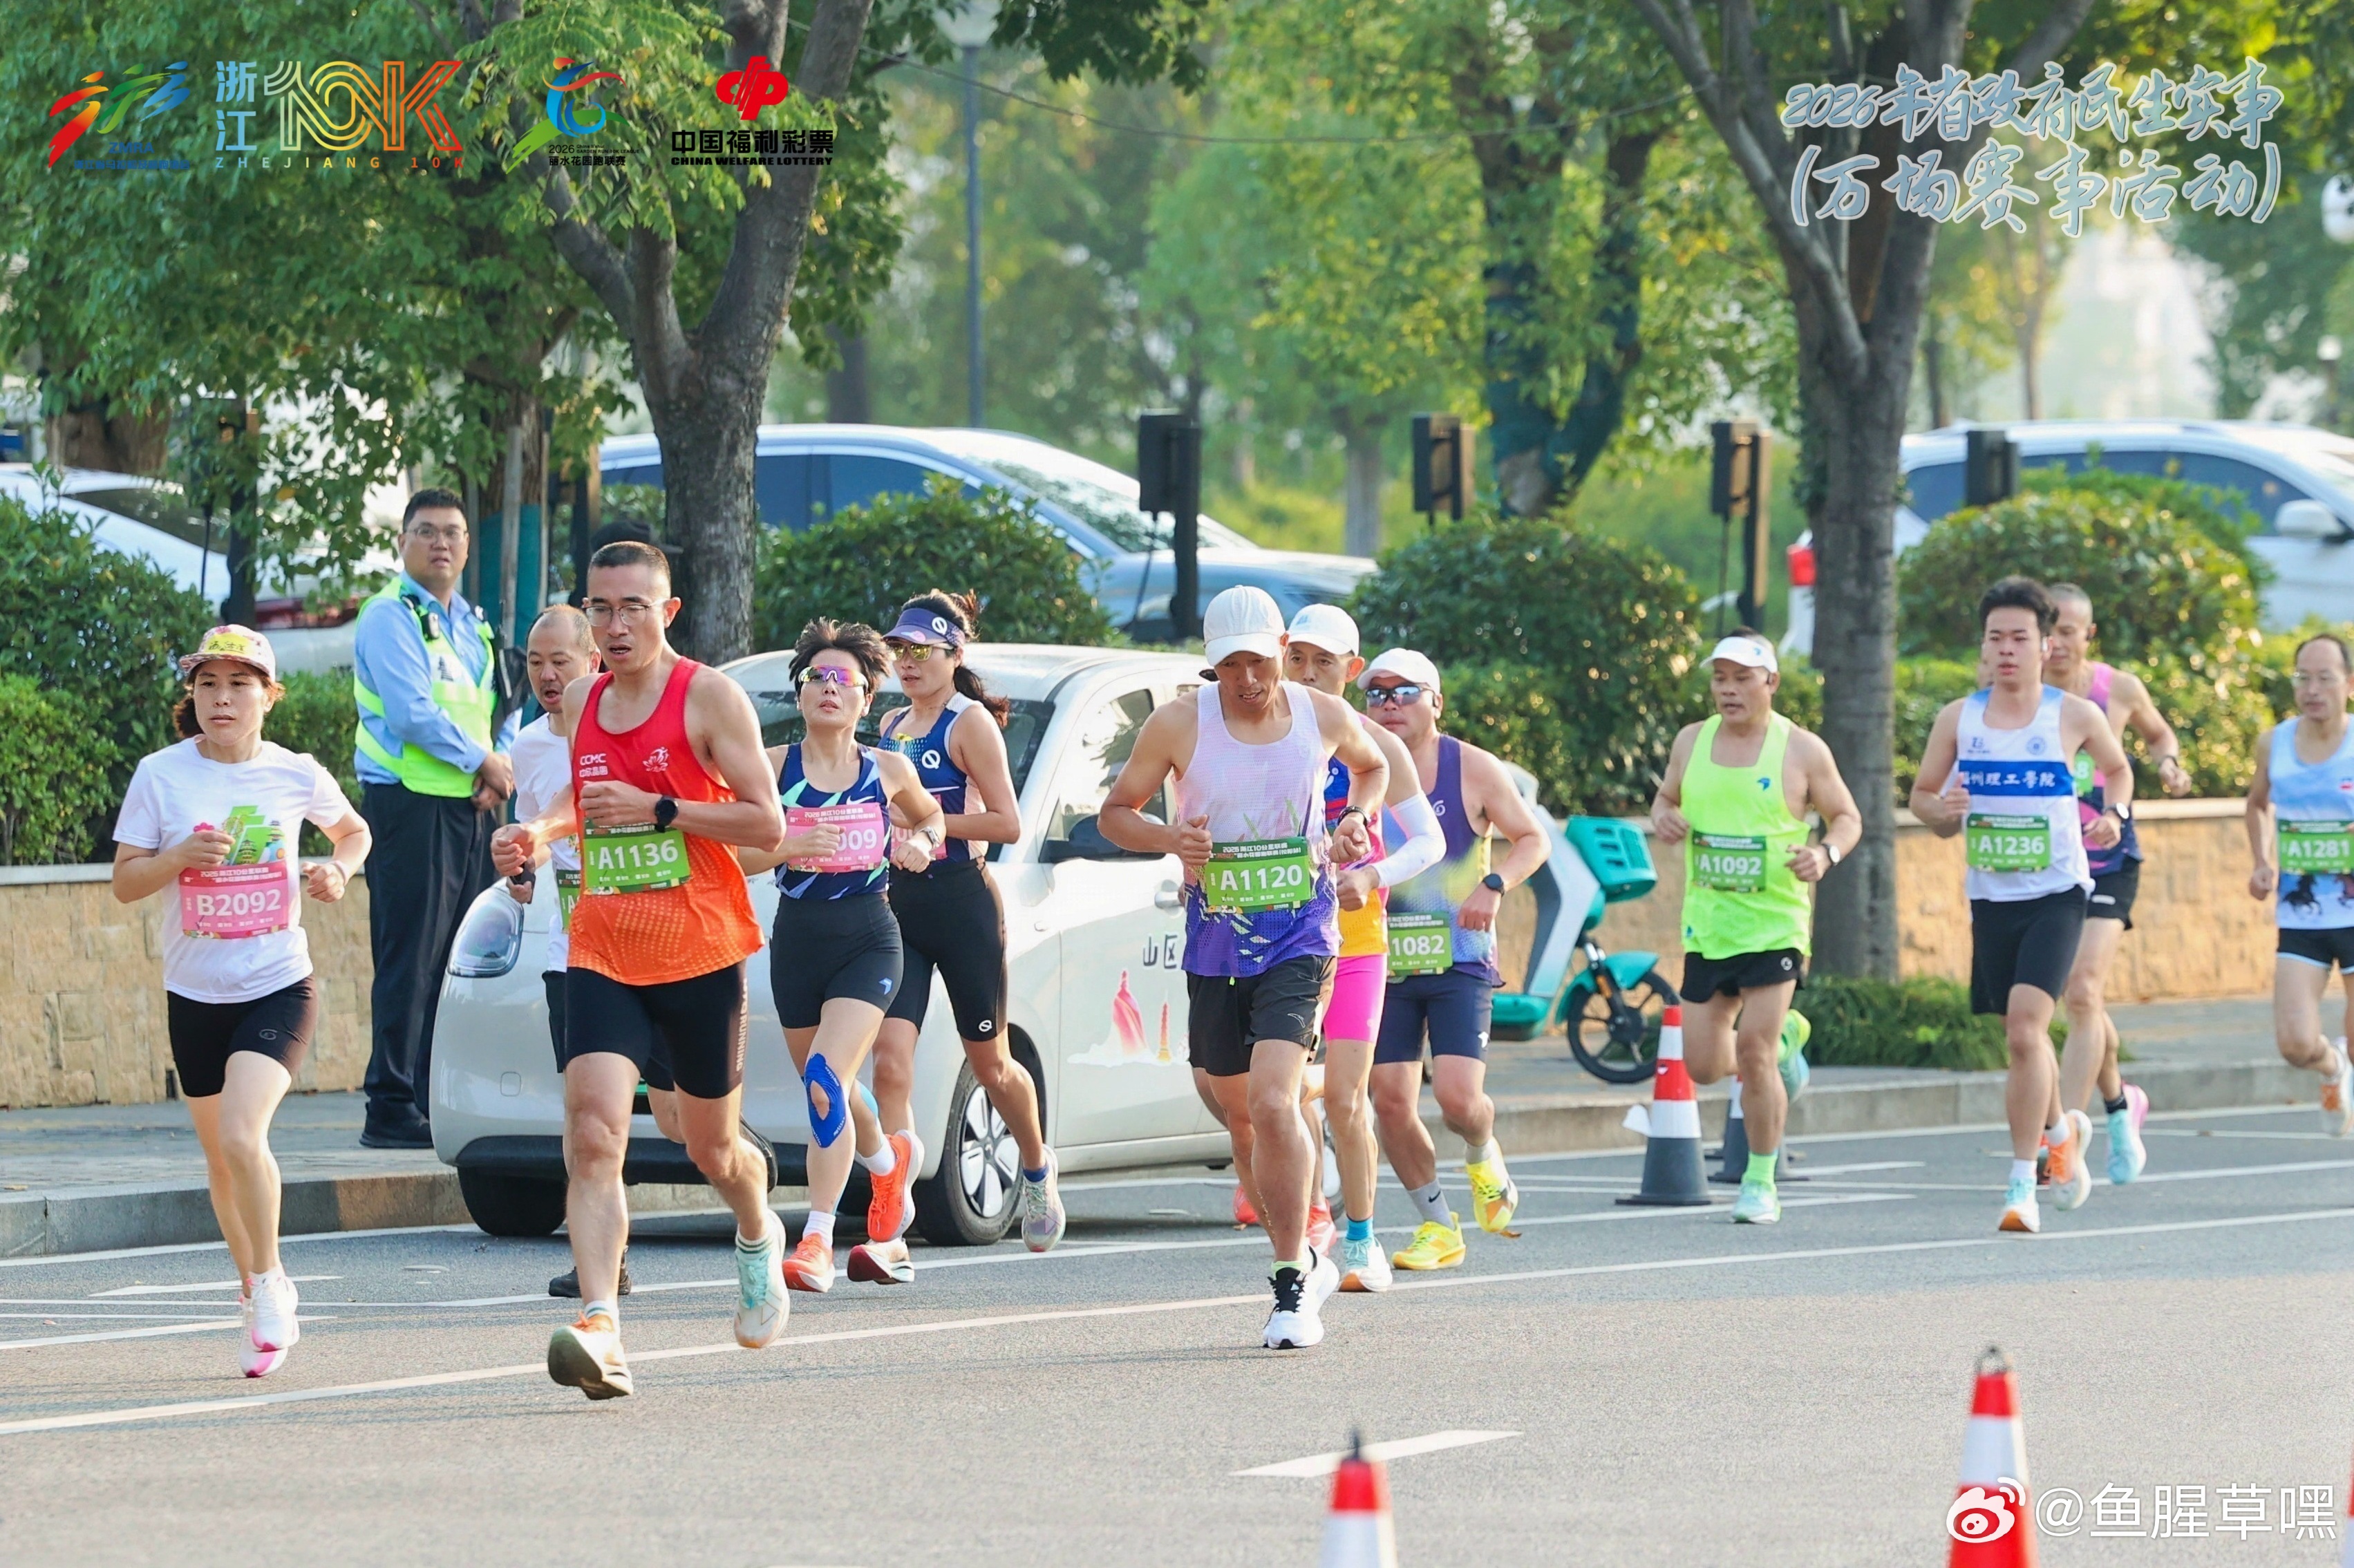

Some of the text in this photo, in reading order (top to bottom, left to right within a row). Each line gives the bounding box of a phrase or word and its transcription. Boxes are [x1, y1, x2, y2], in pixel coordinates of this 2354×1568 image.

[838, 829, 877, 852] 009
[1978, 835, 2046, 855] A1236
[2287, 840, 2351, 858] A1281
[598, 839, 679, 870] A1136
[1699, 853, 1762, 876] A1092
[1221, 865, 1303, 891] A1120
[196, 889, 281, 916] B2092
[1142, 934, 1178, 970] 山区
[1388, 934, 1445, 956] 1082
[736, 1014, 747, 1072] RUNNING
